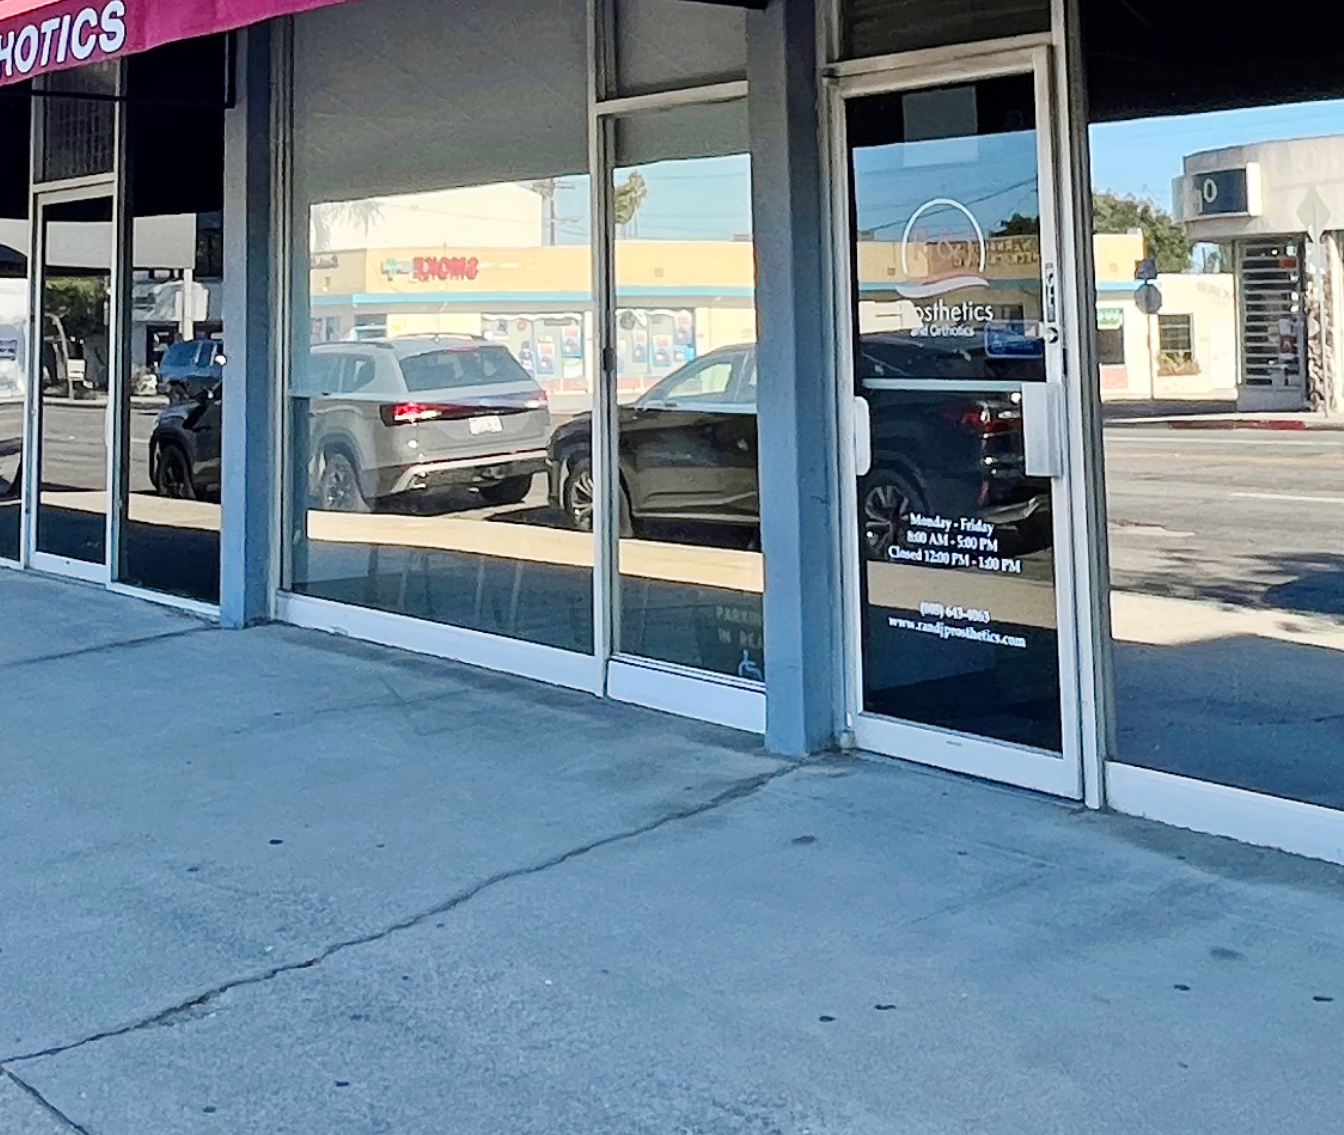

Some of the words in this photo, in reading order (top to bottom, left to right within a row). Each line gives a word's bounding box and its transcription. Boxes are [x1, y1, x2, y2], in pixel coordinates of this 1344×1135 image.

[915, 298, 994, 322] osthetics
[930, 324, 975, 338] Orthotics
[910, 512, 952, 532] Monday
[960, 518, 994, 537] Friday
[929, 533, 949, 546] AM
[957, 535, 978, 549] 5:00
[979, 538, 998, 552] PM
[888, 545, 923, 561] Closed
[924, 549, 950, 564] 12:00
[951, 552, 970, 567] PM
[1001, 558, 1022, 573] PM
